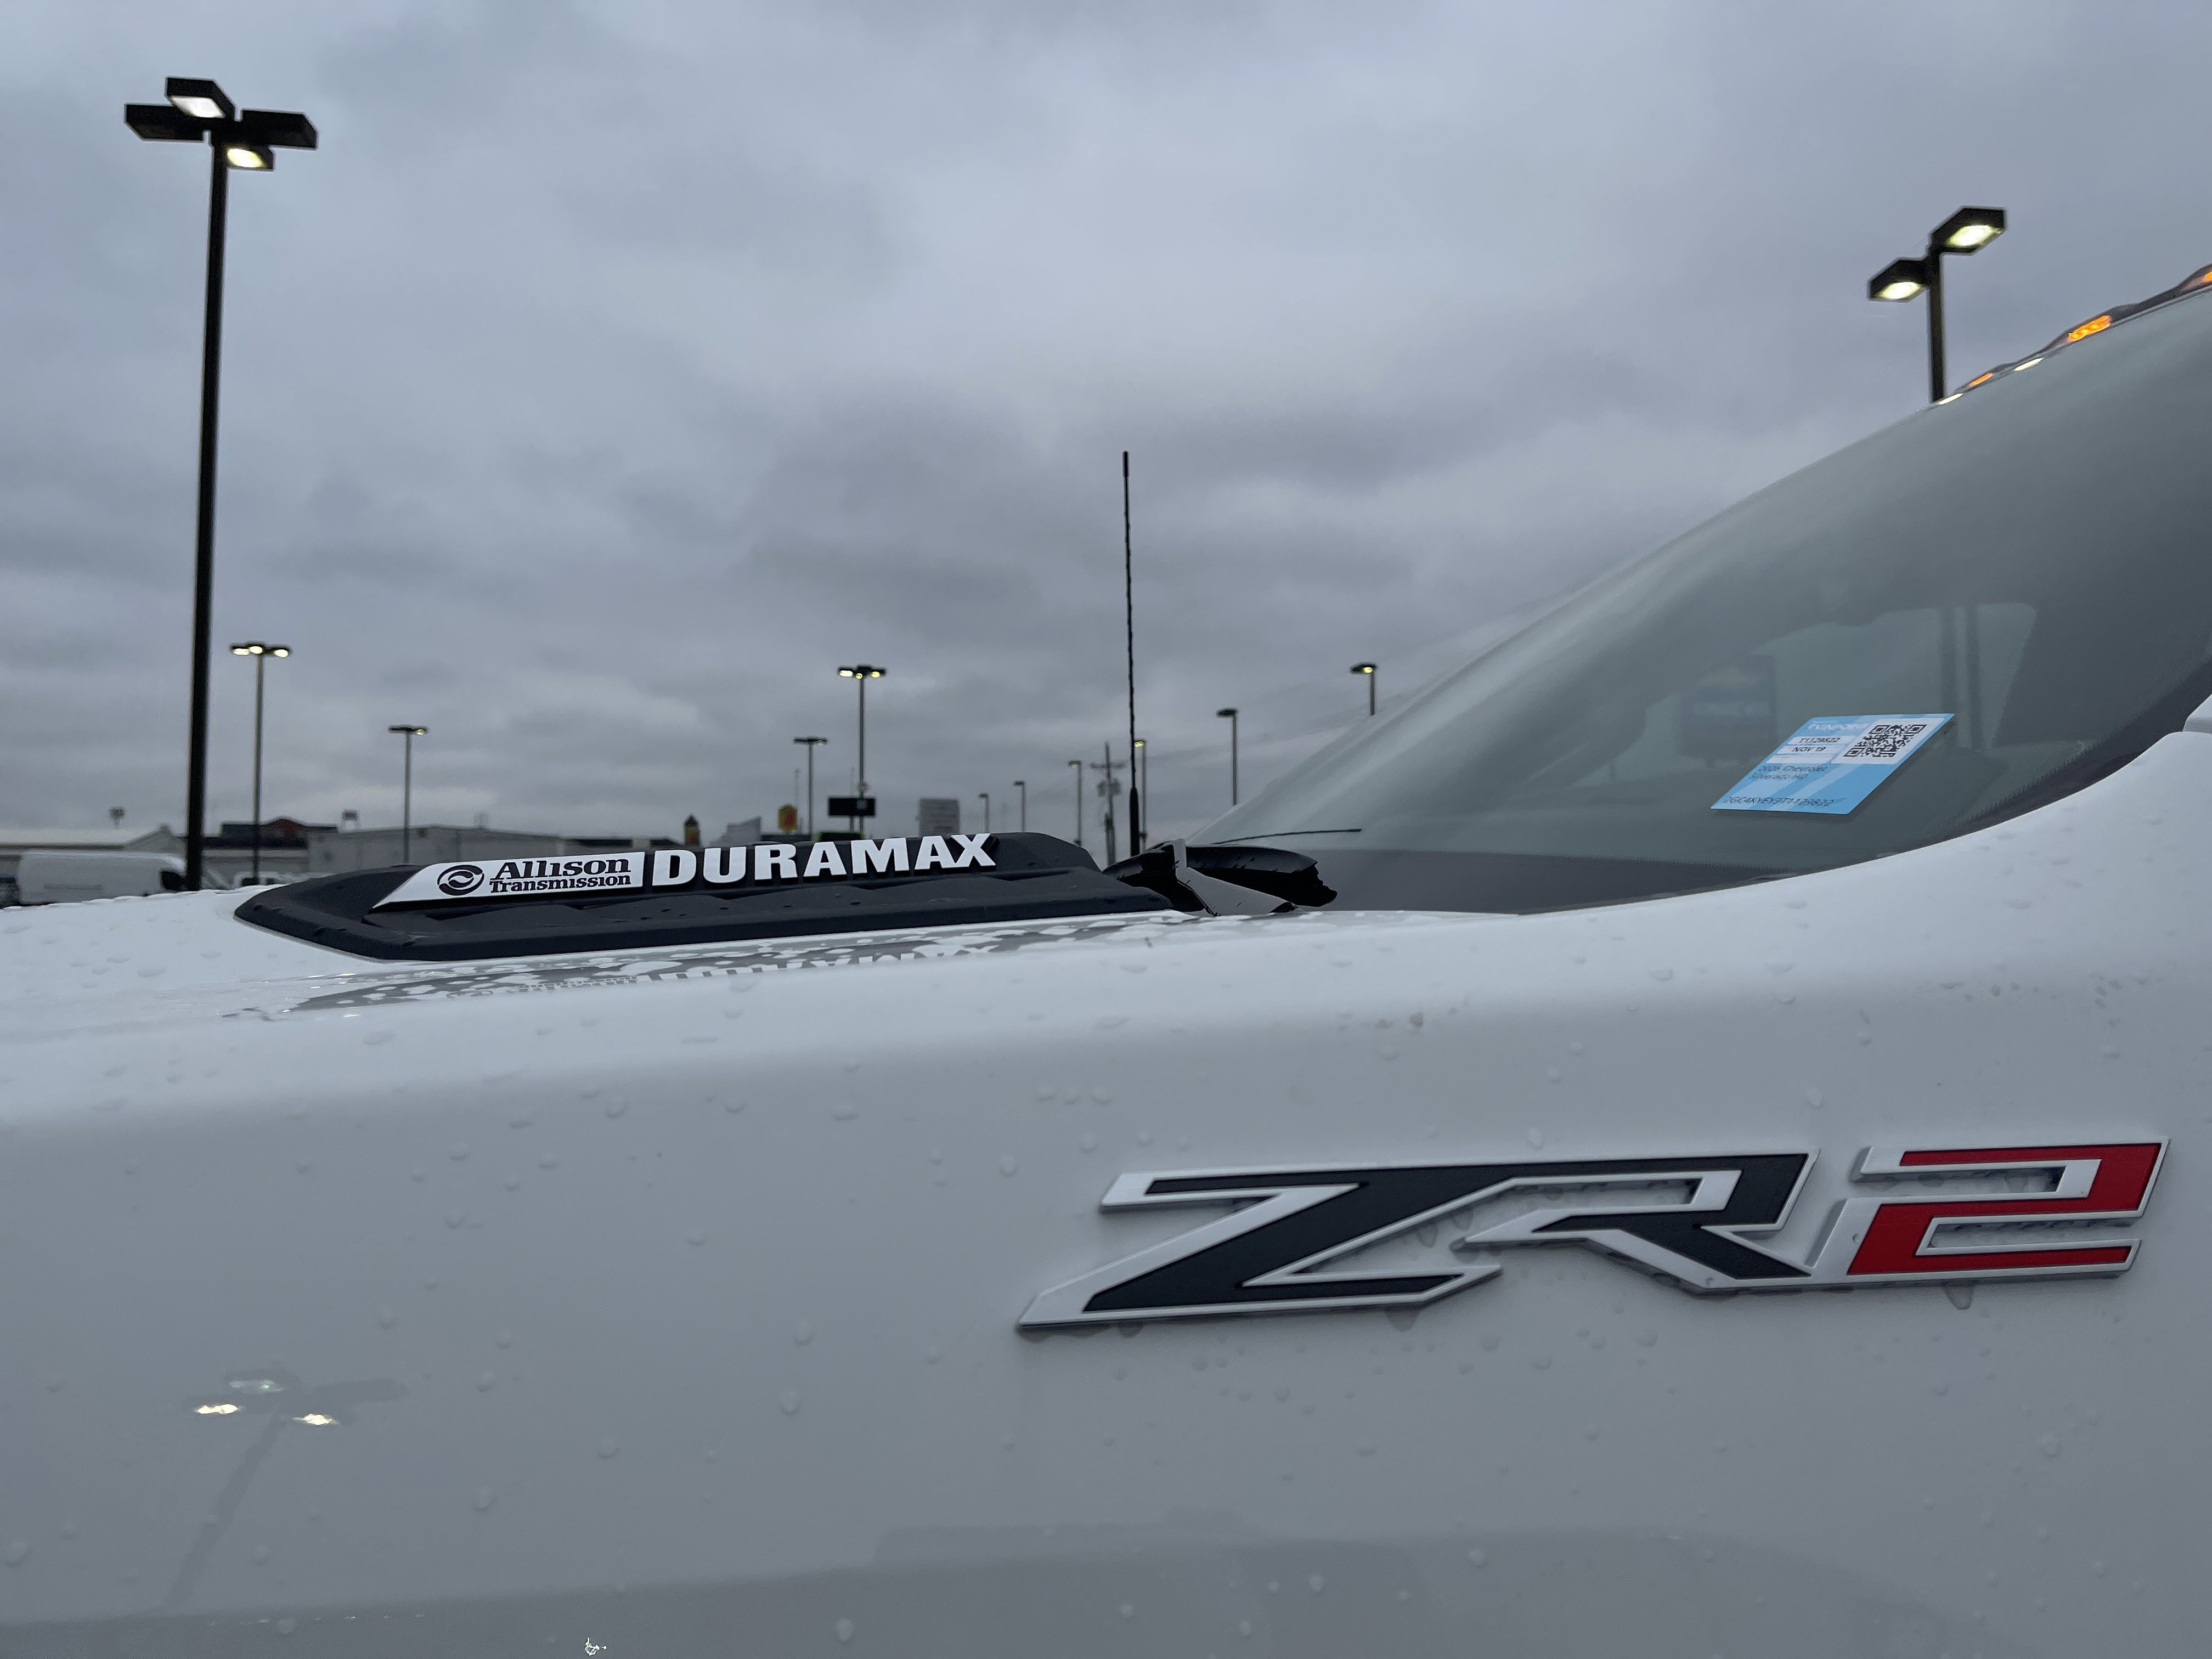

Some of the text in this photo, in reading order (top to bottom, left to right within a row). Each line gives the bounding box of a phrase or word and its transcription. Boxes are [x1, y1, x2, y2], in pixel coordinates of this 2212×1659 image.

[495, 858, 631, 880] Allison
[652, 832, 996, 887] DURAMAX
[488, 874, 631, 893] Transmission
[1018, 1137, 2170, 1329] ZR2
